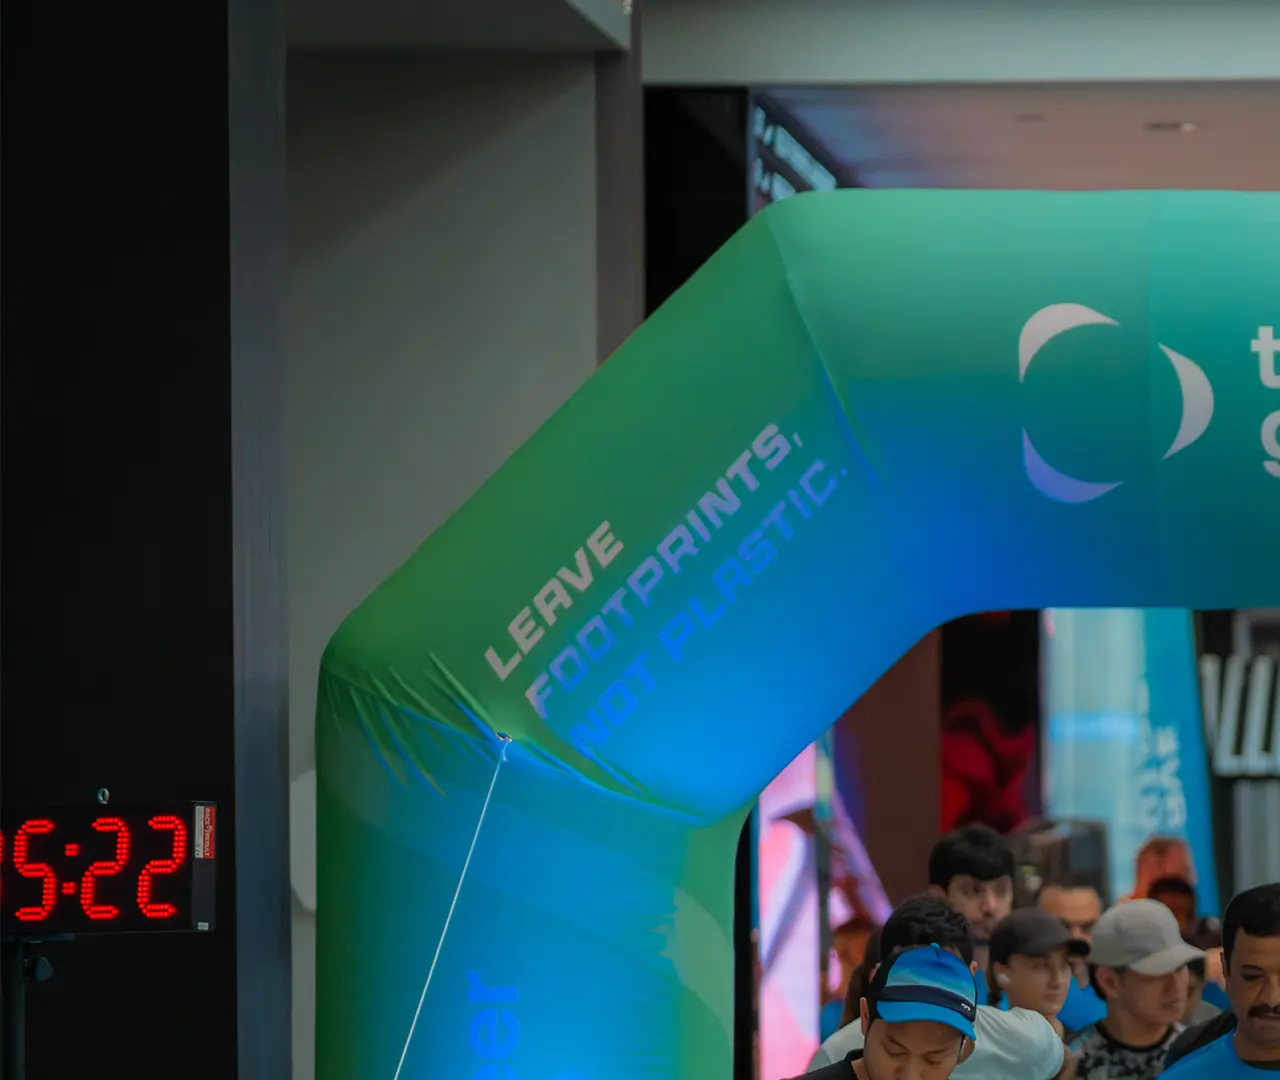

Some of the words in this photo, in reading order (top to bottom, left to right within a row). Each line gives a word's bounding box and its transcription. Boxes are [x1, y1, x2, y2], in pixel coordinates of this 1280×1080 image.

[484, 520, 624, 681] LEAVE
[525, 422, 803, 719] FOOTPRINTS,
[568, 652, 657, 759] NOT
[657, 459, 848, 662] PLASTIC.
[0, 815, 188, 921] 5:22
